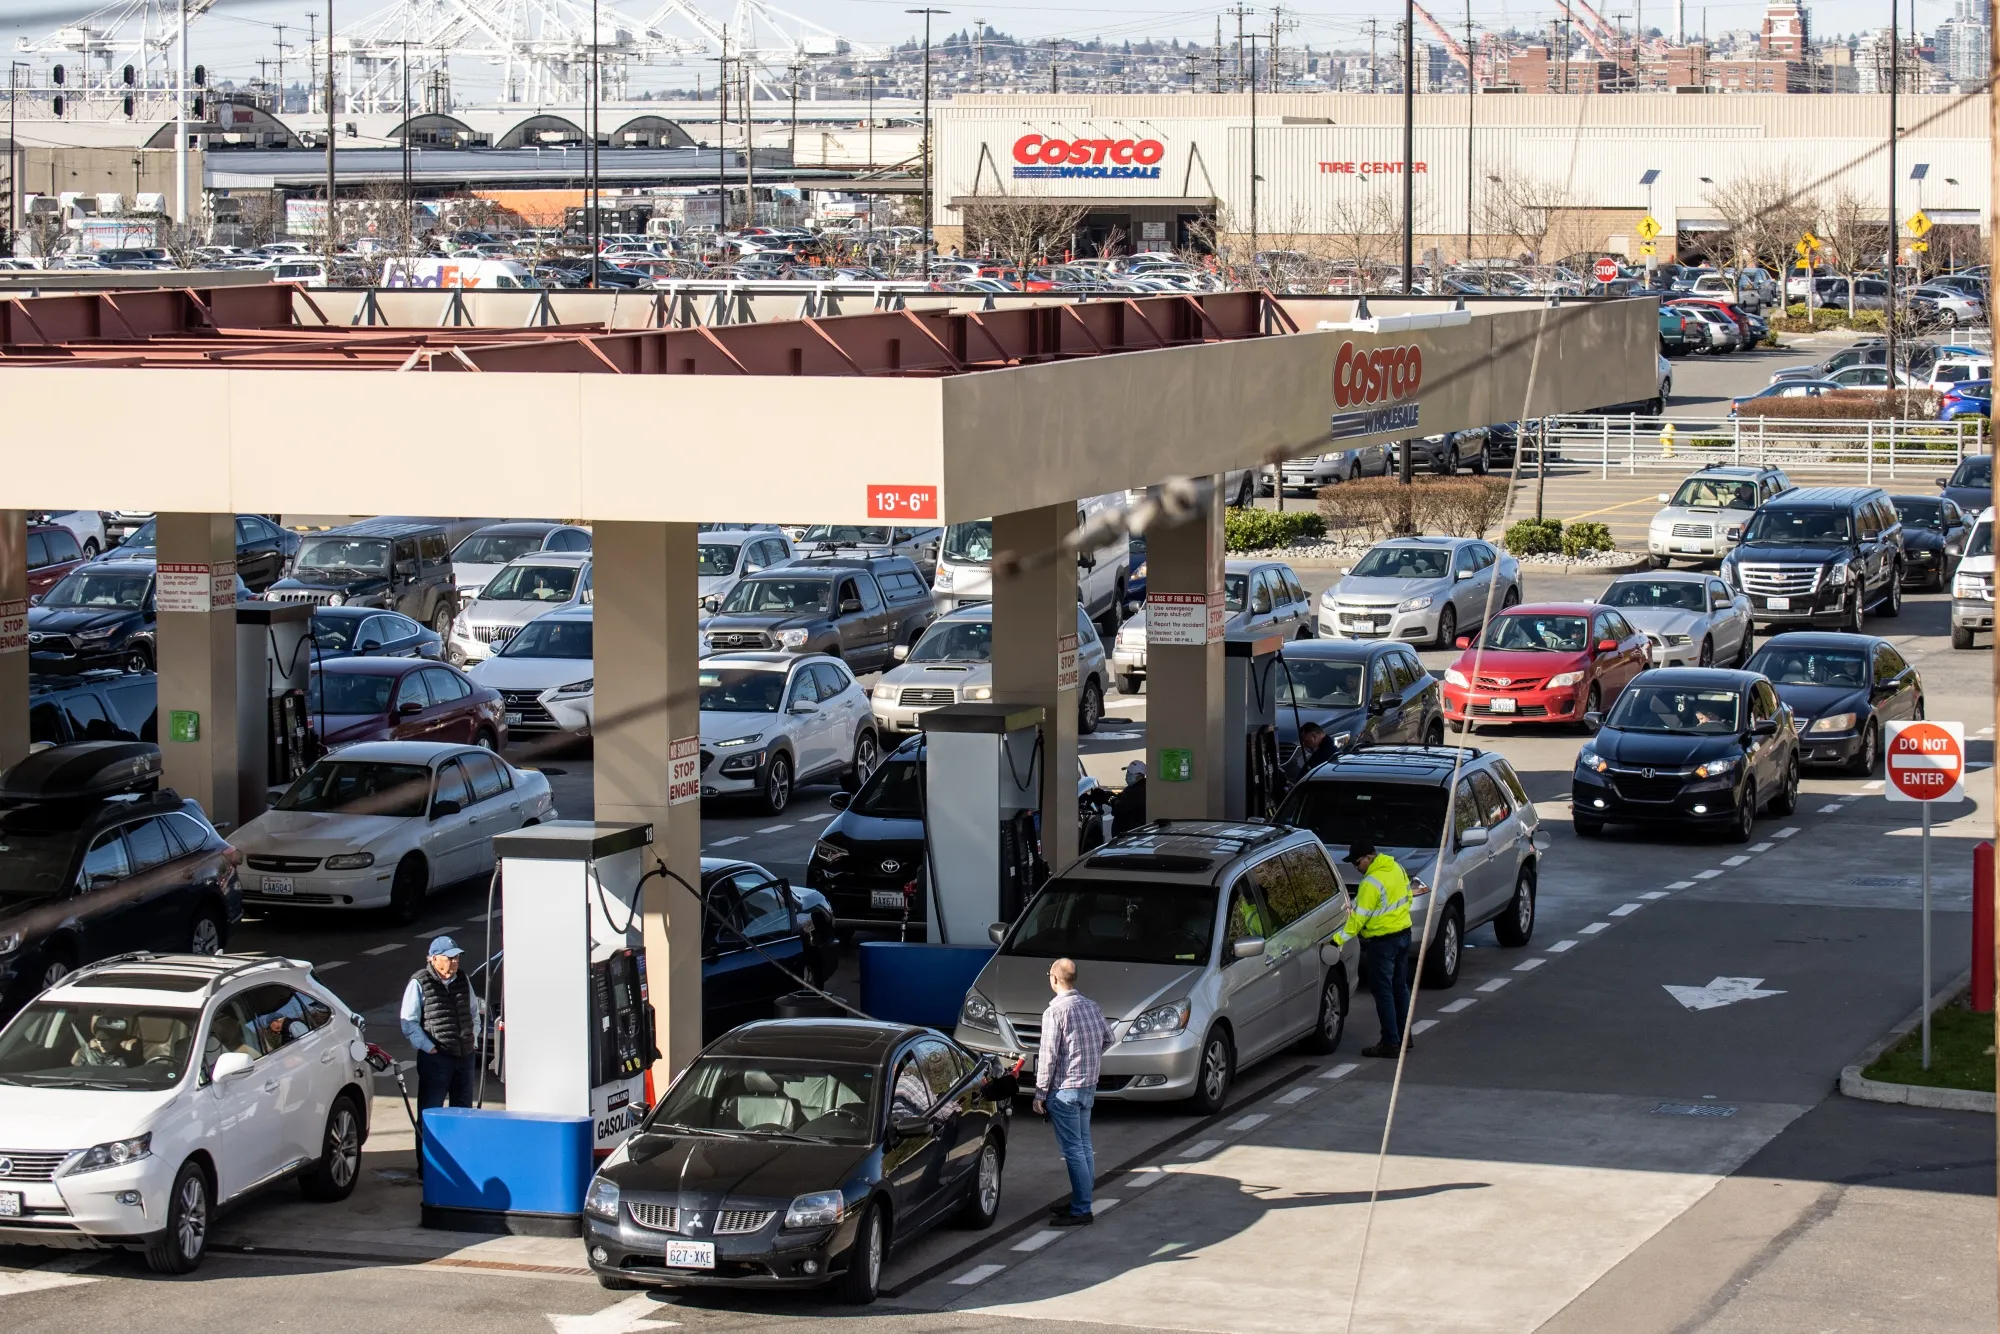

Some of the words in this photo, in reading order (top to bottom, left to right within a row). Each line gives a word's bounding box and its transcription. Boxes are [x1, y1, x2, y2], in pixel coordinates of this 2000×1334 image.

[1013, 134, 1164, 165] COSTCO
[1060, 167, 1160, 179] WHOLESALE
[1318, 162, 1355, 173] TIRE
[1360, 162, 1428, 173] CENTR
[1596, 266, 1616, 275] STOP
[1333, 340, 1422, 409] COSTCO
[1364, 403, 1419, 434] WHOLESALE
[876, 492, 928, 511] 13'-6"
[215, 579, 232, 592] STOP
[212, 593, 235, 606] ENGINE
[1210, 610, 1222, 623] STOP
[4, 619, 23, 632] STOP
[1208, 625, 1224, 639] ENGINE
[0, 634, 27, 649] ENGINE
[1061, 655, 1074, 669] STOP
[1059, 671, 1077, 686] ENGINE
[1900, 738, 1918, 750] DO
[1922, 738, 1948, 750] NOT
[674, 761, 694, 779] STOP
[1903, 772, 1944, 785] ENTER
[670, 779, 698, 800] ENGINE
[646, 827, 652, 841] 18
[264, 883, 291, 892] CAA5043
[598, 1112, 638, 1140] GASOLIN
[670, 1250, 711, 1263] 627-XKE
